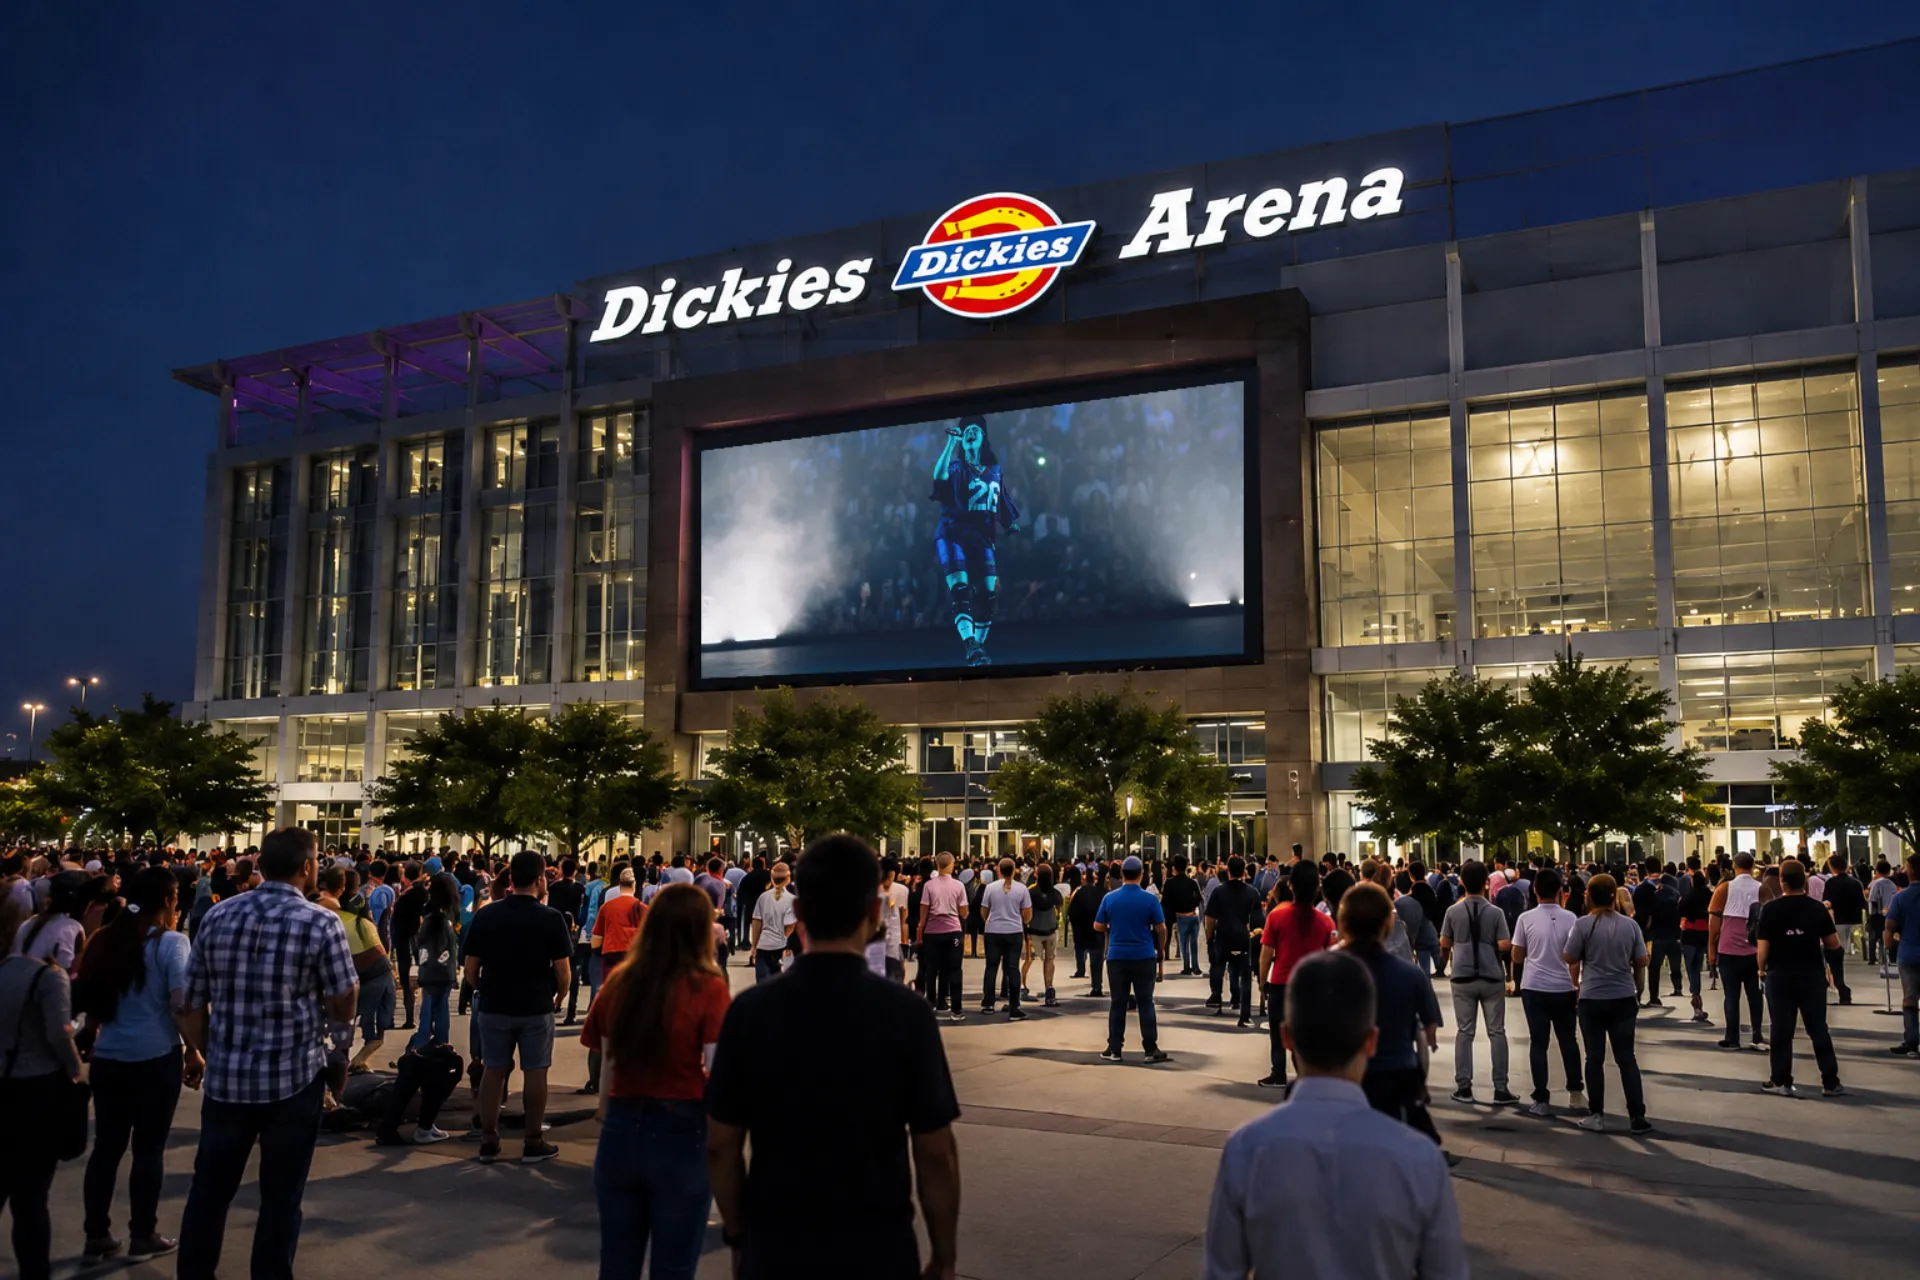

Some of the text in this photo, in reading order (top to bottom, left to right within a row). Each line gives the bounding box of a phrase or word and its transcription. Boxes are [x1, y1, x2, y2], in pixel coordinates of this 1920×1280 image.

[589, 166, 1405, 343] Dickies Arena
[911, 235, 1074, 279] Dickies
